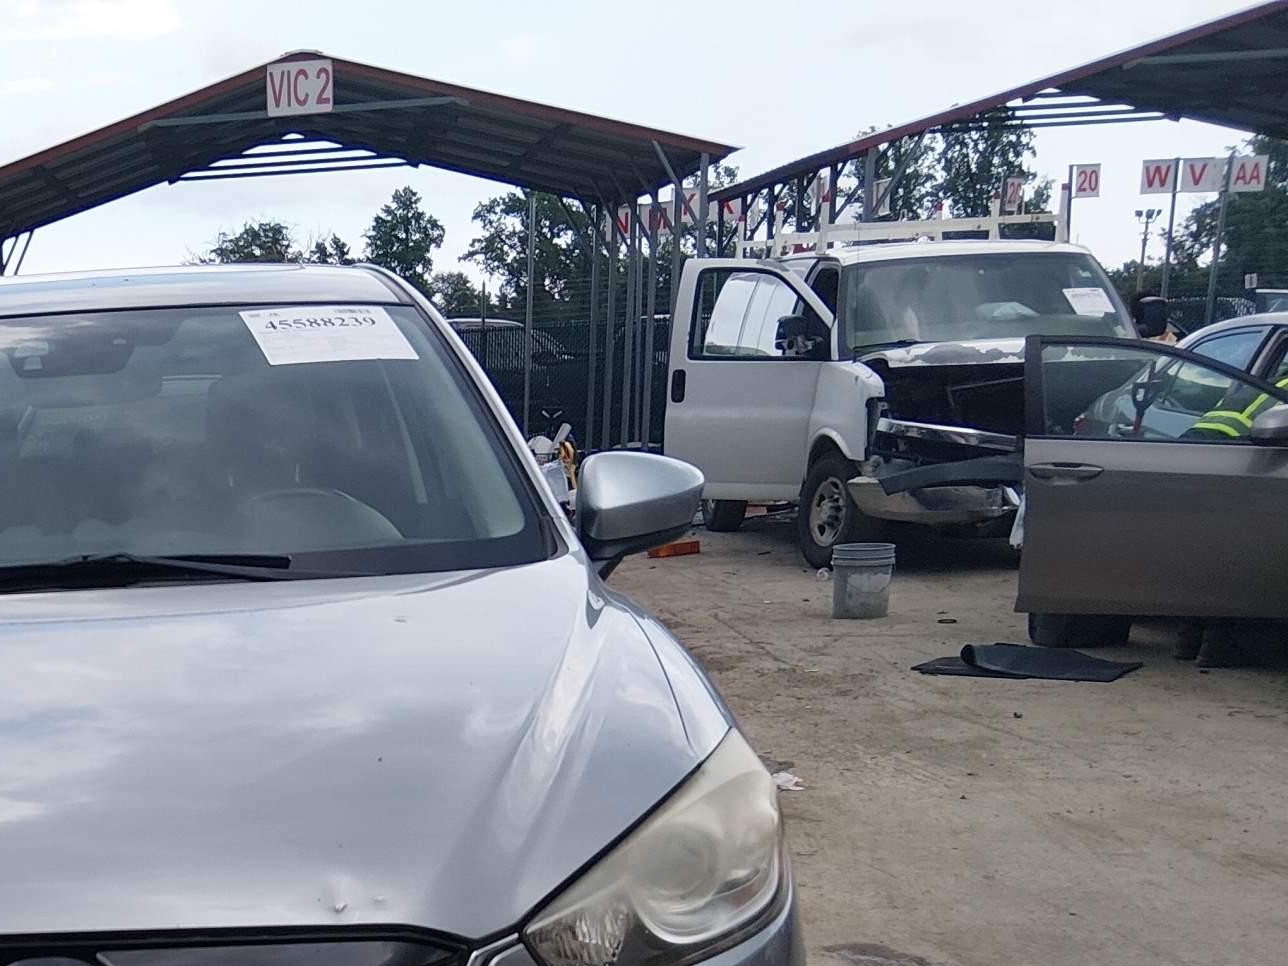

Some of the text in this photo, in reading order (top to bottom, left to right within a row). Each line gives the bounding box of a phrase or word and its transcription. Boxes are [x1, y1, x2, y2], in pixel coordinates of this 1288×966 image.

[269, 67, 330, 109] VIC 2
[1078, 169, 1098, 192] 20
[1145, 164, 1171, 188] W
[1189, 163, 1208, 186] V
[1234, 162, 1261, 185] AA
[265, 316, 376, 331] 45588239
